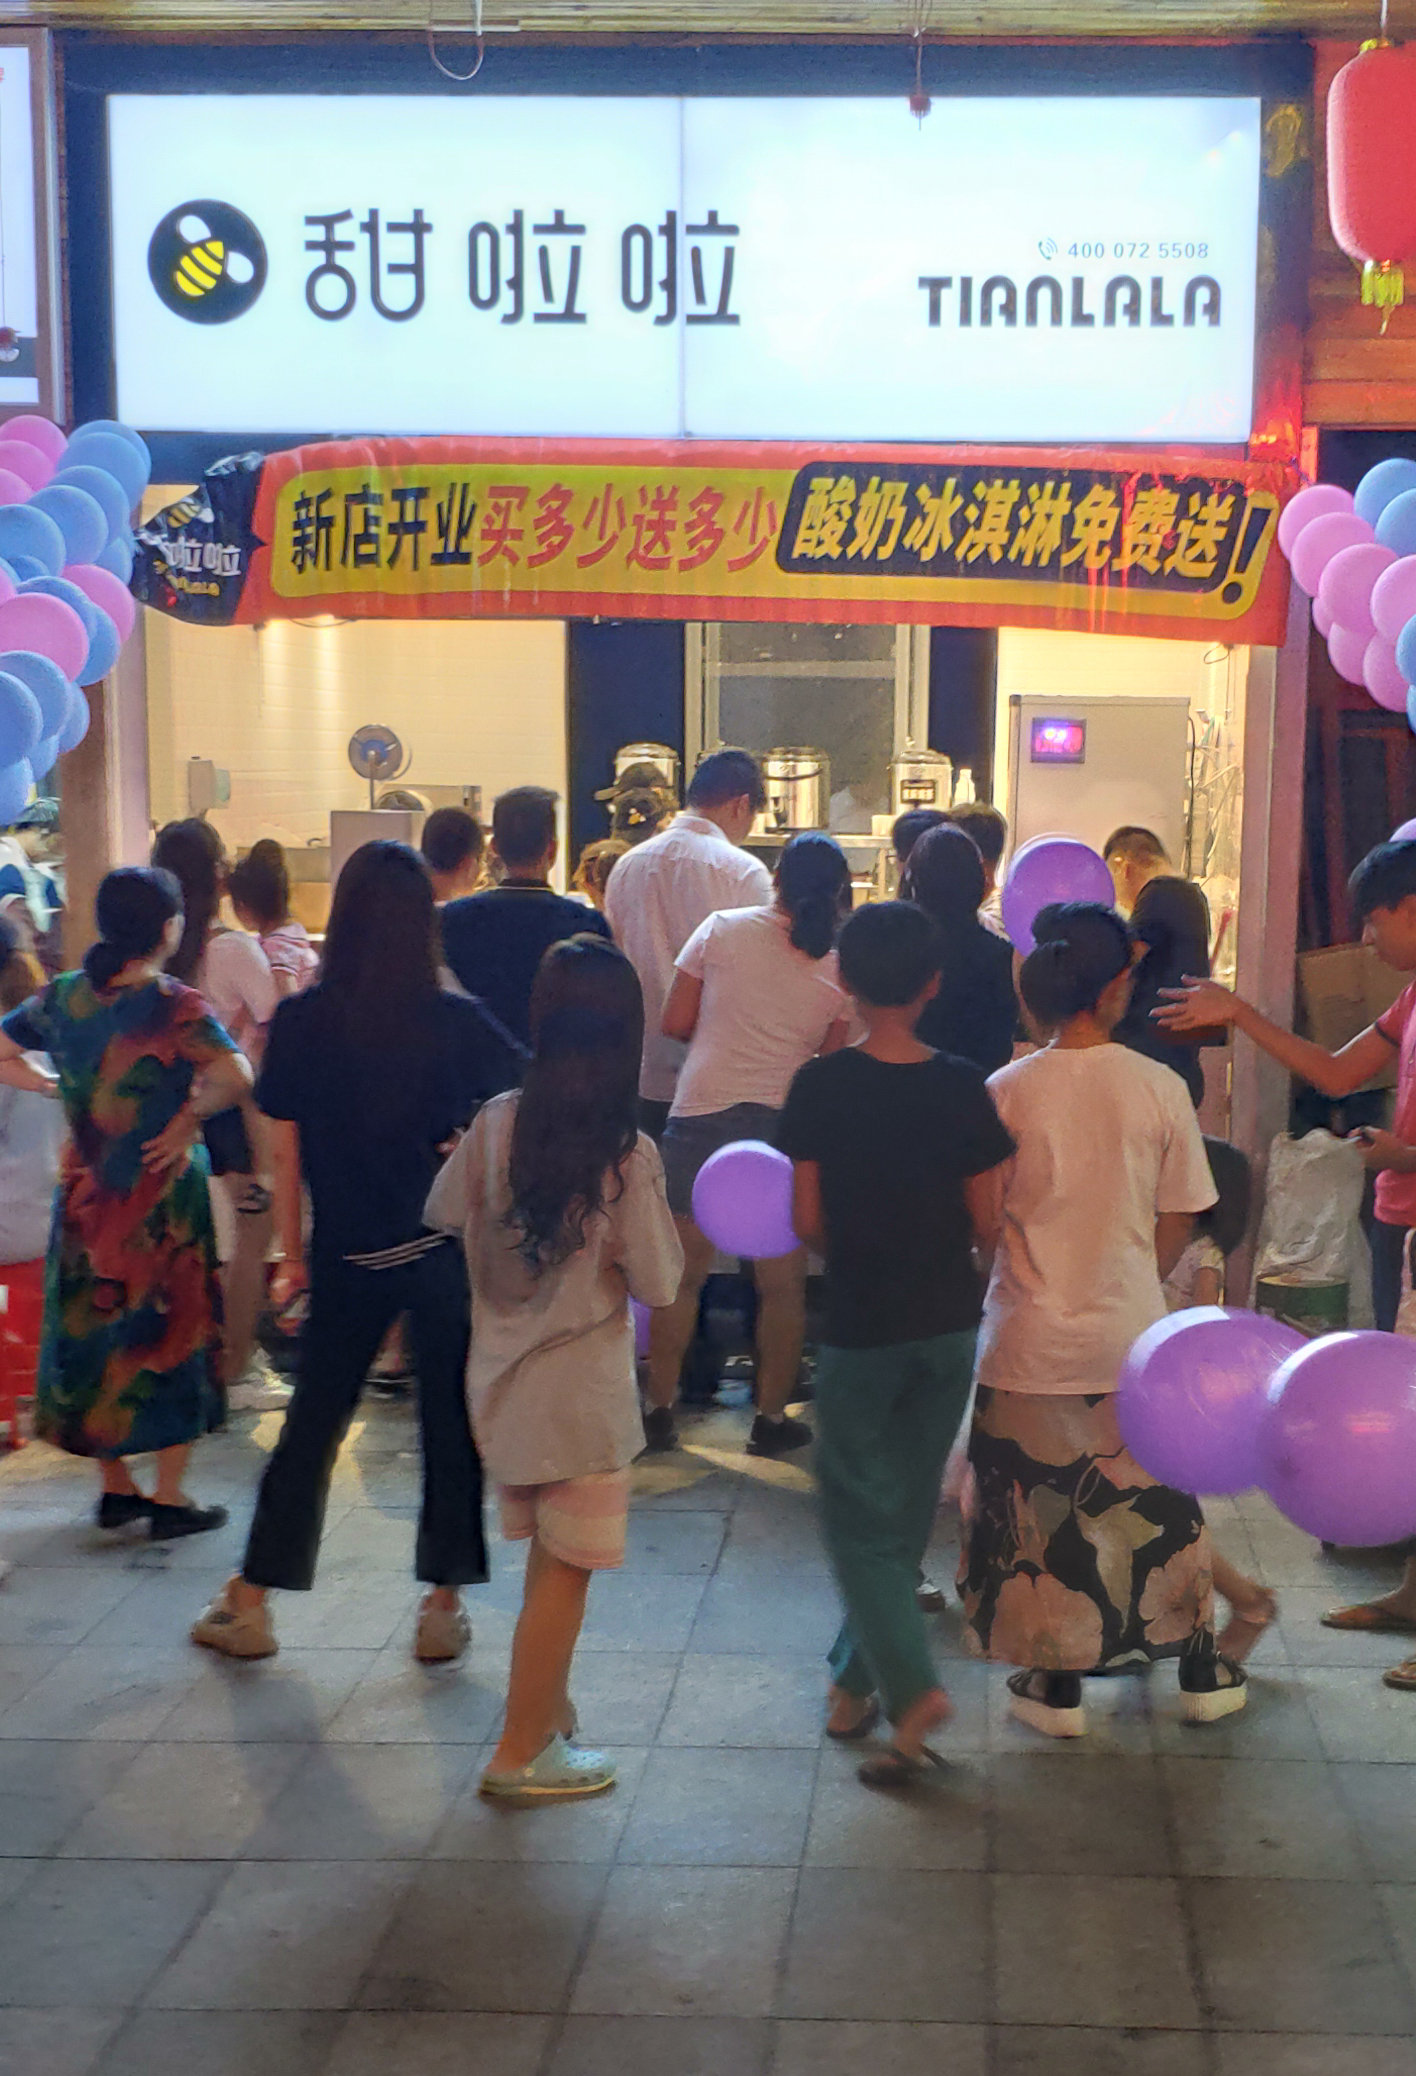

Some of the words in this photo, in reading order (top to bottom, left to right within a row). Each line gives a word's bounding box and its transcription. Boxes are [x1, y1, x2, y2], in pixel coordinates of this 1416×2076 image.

[305, 208, 741, 325] 甜啦啦
[1068, 242, 1105, 259] 400
[1113, 242, 1150, 259] 072
[1158, 242, 1209, 259] 5508
[918, 275, 1221, 327] TIANLALA
